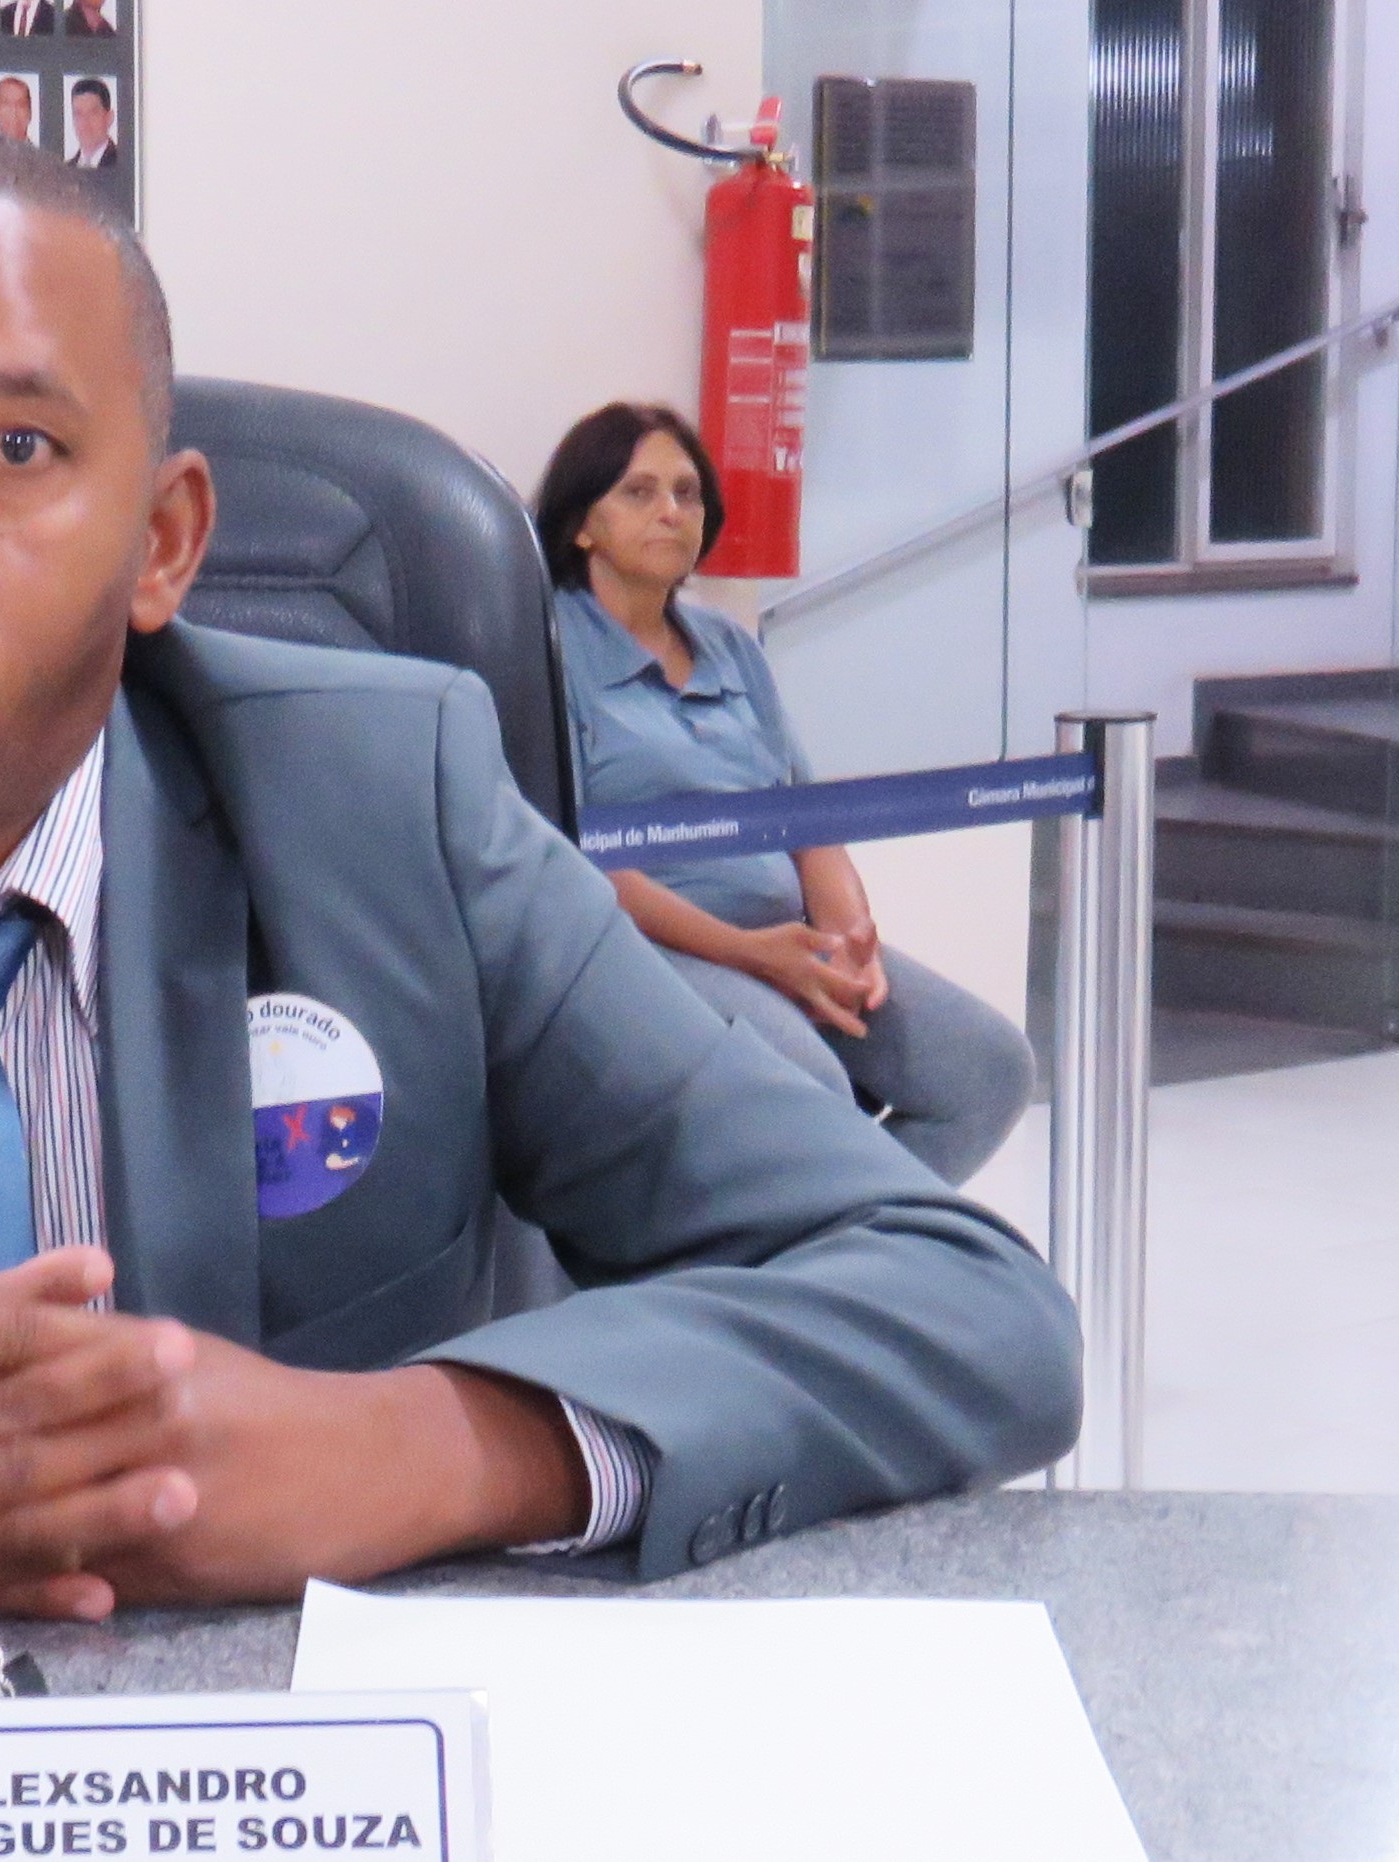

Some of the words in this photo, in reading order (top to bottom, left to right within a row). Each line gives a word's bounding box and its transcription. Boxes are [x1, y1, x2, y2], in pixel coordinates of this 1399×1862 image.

[625, 827, 645, 847] de
[259, 1000, 341, 1041] dourado
[149, 1817, 217, 1852] DE
[237, 1814, 422, 1850] SOUZA
